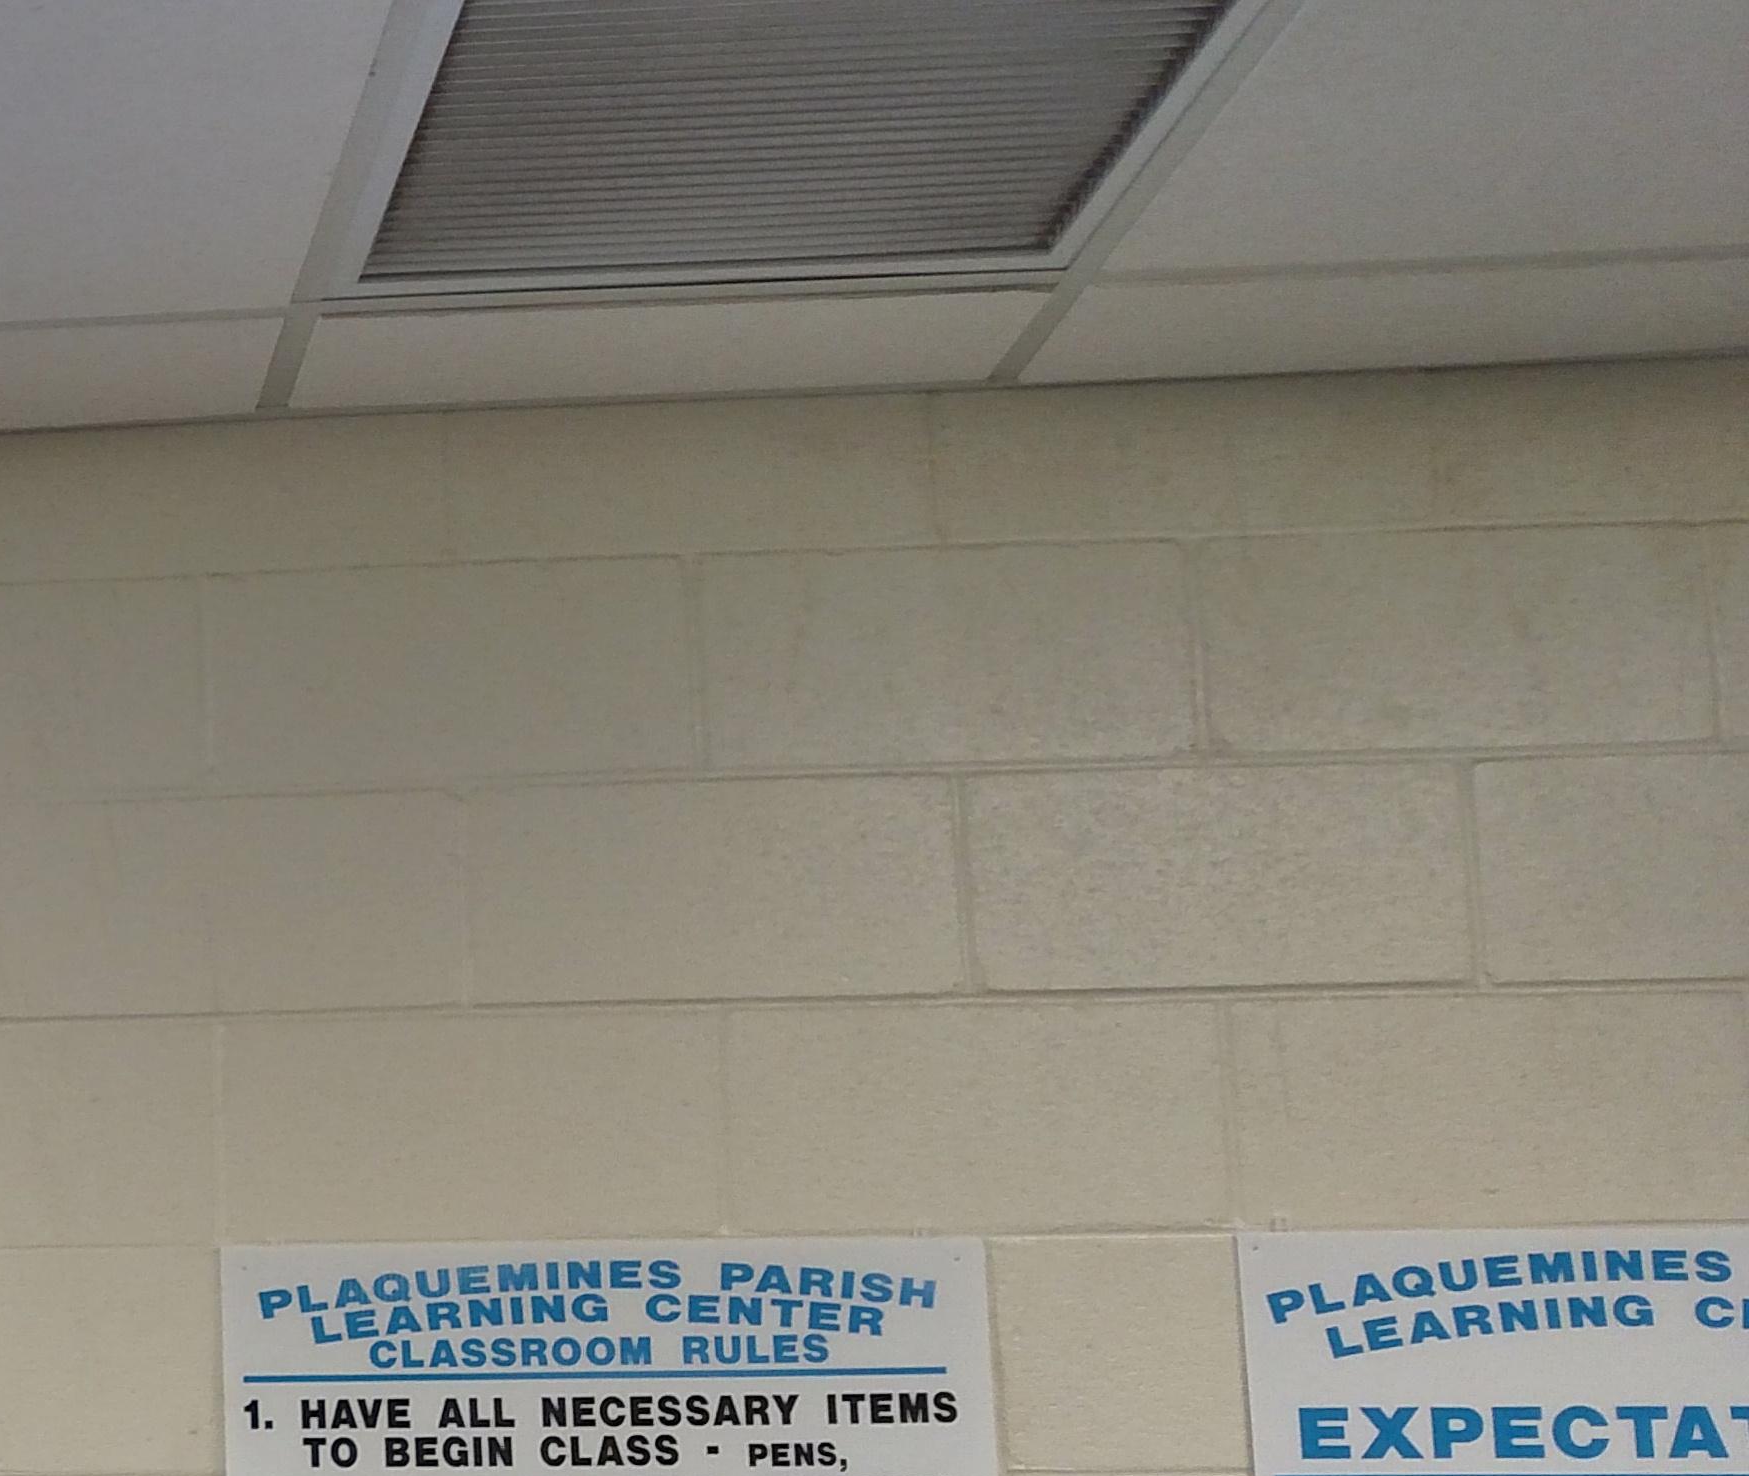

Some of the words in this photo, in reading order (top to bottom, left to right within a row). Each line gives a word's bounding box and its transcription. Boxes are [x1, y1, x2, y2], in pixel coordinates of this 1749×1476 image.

[258, 1259, 682, 1321] PLAQUEMINES
[720, 1262, 937, 1309] PARISH
[1267, 1249, 1732, 1325] PLAQUEMINES
[310, 1294, 610, 1345] LEARNING
[646, 1294, 885, 1337] CENTER
[1326, 1294, 1655, 1360] LEARNING
[370, 1337, 651, 1368] CLASSROOM
[683, 1334, 828, 1364] RULES
[244, 1400, 273, 1429] 1.
[301, 1399, 410, 1429] HAVE
[439, 1398, 515, 1428] ALL
[542, 1395, 799, 1427] NECESSARY
[827, 1392, 957, 1424] ITEMS
[303, 1437, 357, 1467] TO
[385, 1437, 512, 1467] BEGIN
[541, 1435, 678, 1466] CLASS
[749, 1442, 847, 1472] PENS,
